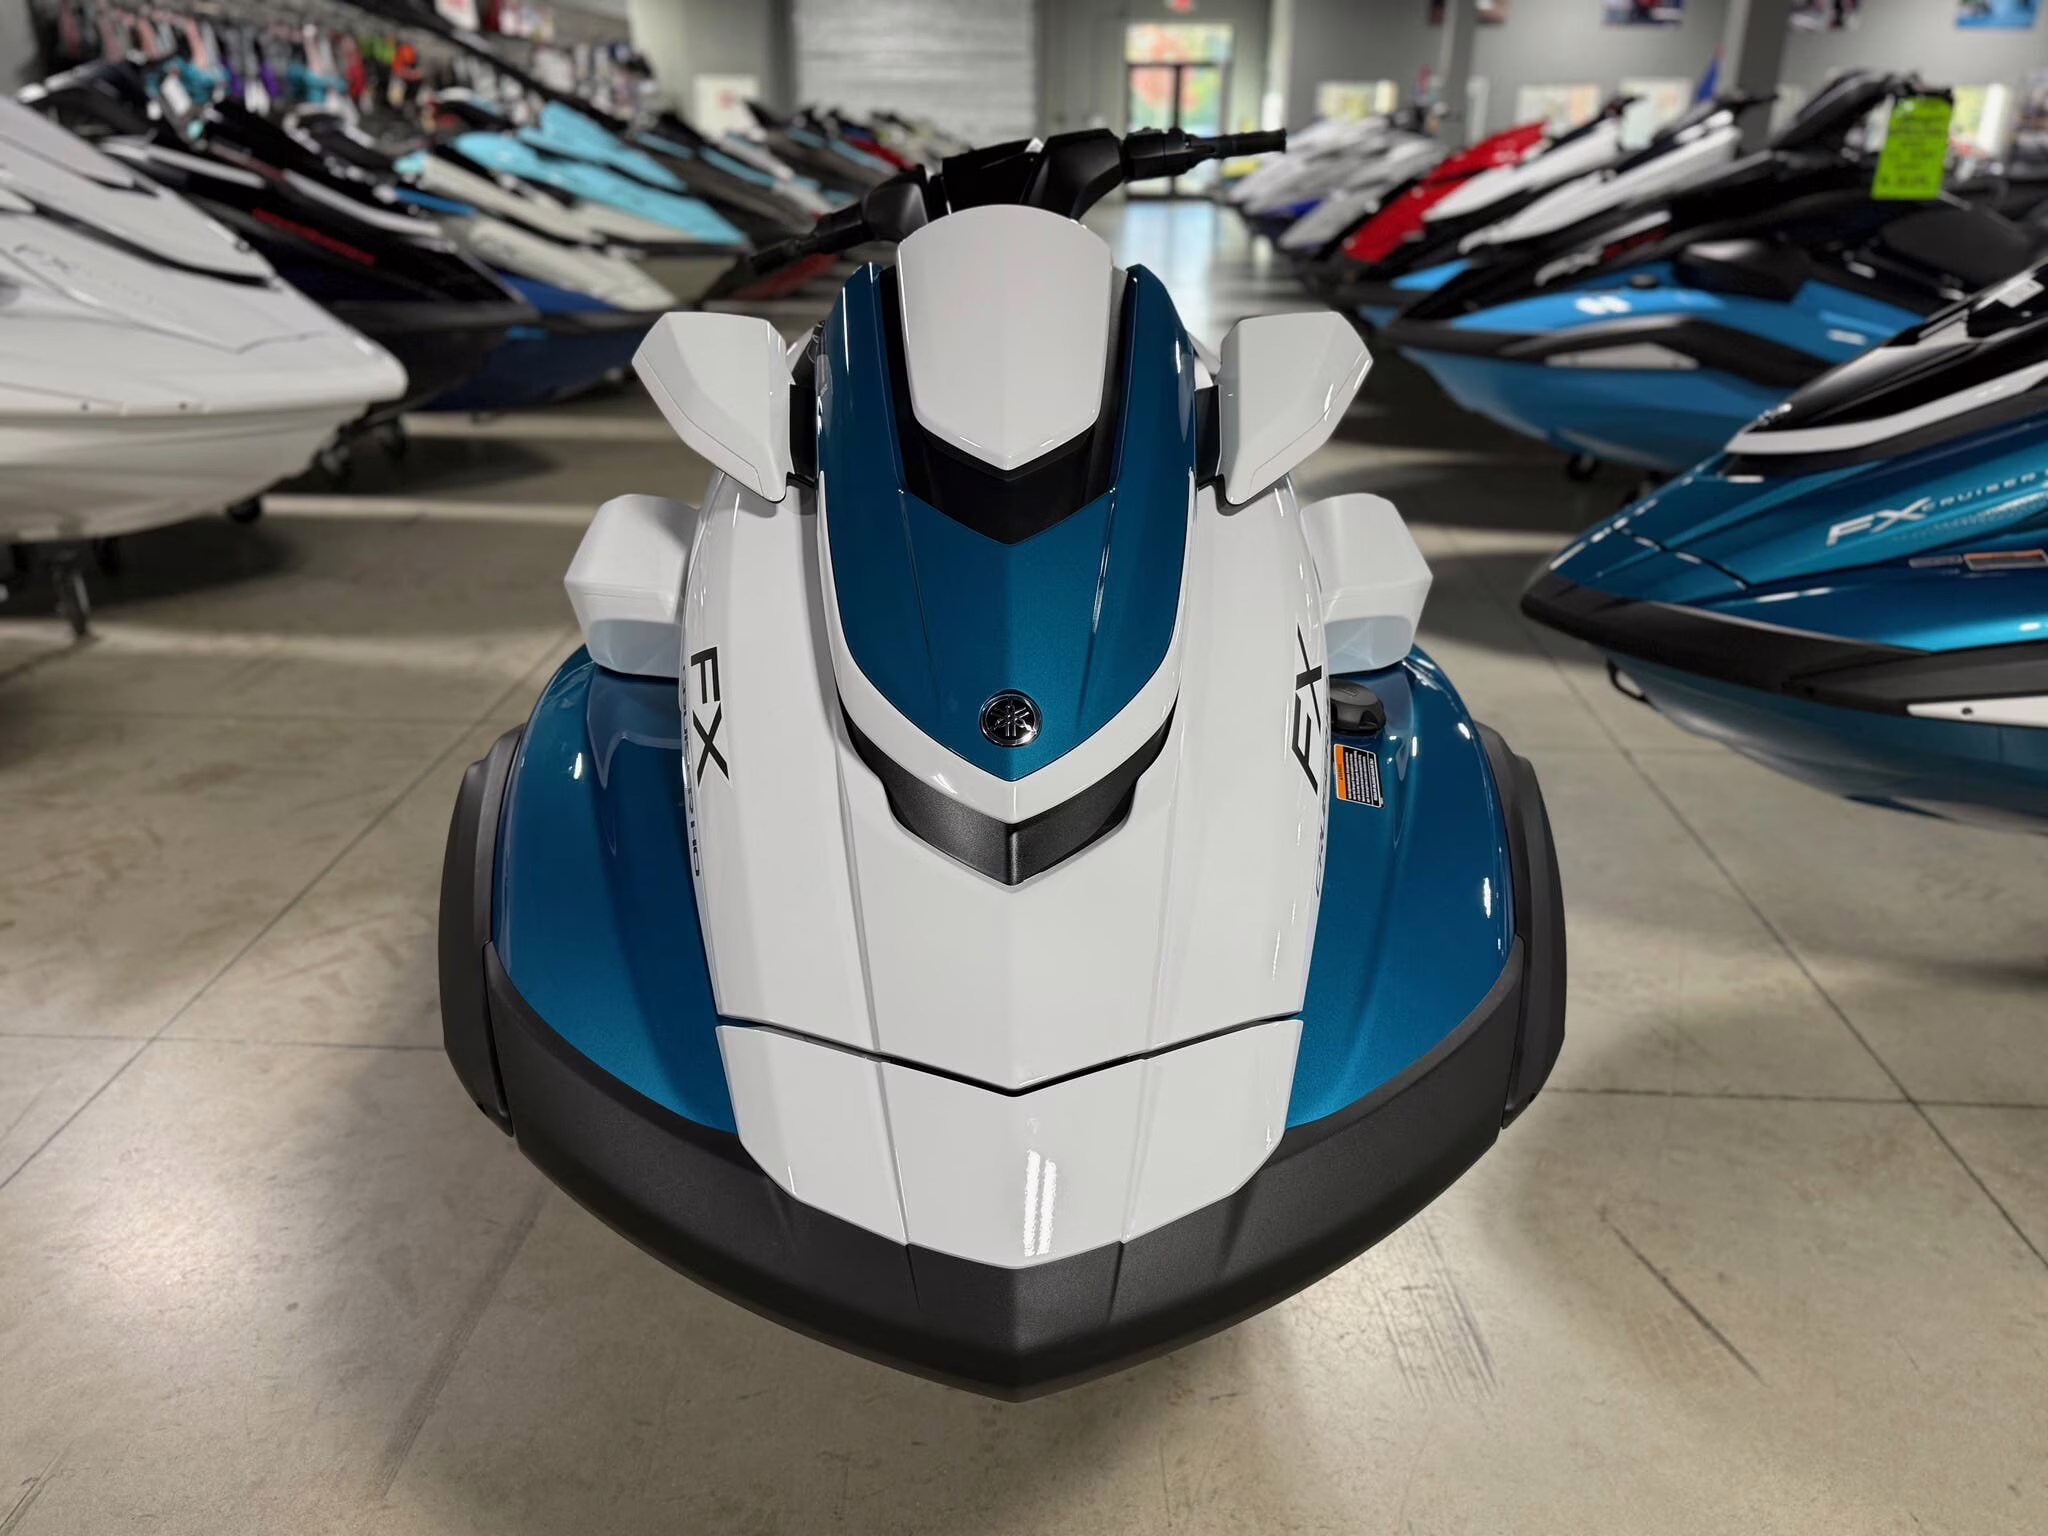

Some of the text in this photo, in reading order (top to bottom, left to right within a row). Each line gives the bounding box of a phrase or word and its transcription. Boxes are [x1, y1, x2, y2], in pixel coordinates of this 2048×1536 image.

[1827, 472, 2037, 546] FX CRUISER
[690, 646, 729, 787] FX
[1291, 622, 1322, 796] FX
